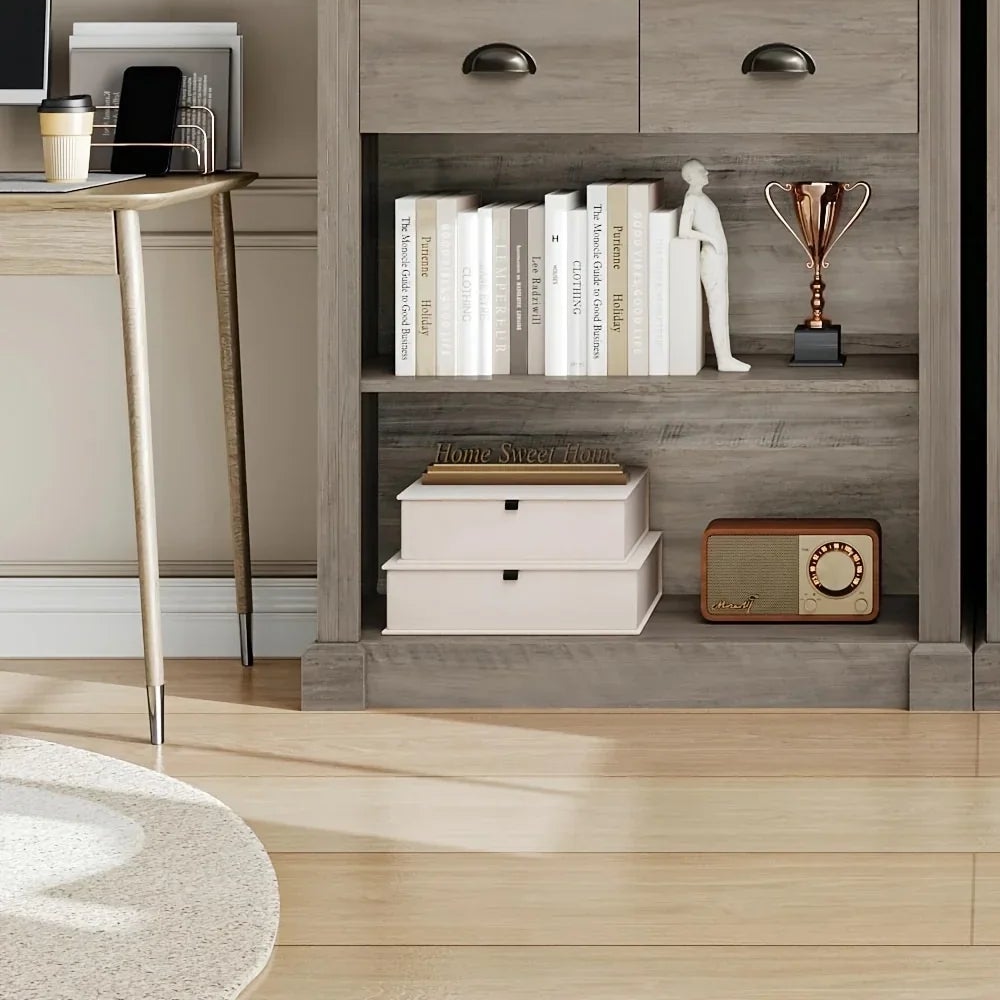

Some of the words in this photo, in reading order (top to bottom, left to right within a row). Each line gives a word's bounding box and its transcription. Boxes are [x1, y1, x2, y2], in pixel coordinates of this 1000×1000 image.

[401, 217, 410, 232] The
[593, 204, 602, 221] The
[401, 235, 410, 268] Monocle
[552, 235, 559, 243] H
[593, 224, 602, 259] Monocle
[613, 226, 623, 270] Purienne
[421, 236, 431, 277] Purienne
[531, 256, 541, 274] Lee
[401, 270, 410, 292] Guide
[572, 260, 582, 315] CLOTHING
[593, 261, 602, 286] Guide
[401, 295, 410, 303] to
[462, 267, 472, 322] CLOTHING
[531, 278, 541, 325] Radziwill
[593, 289, 602, 297] to
[401, 305, 410, 326] Good
[420, 300, 432, 336] Holiday
[593, 299, 602, 322] Good
[610, 294, 623, 333] Holiday
[401, 329, 410, 361] Business
[593, 325, 602, 360] Business
[434, 442, 492, 464] Home
[498, 442, 556, 464] Sweet
